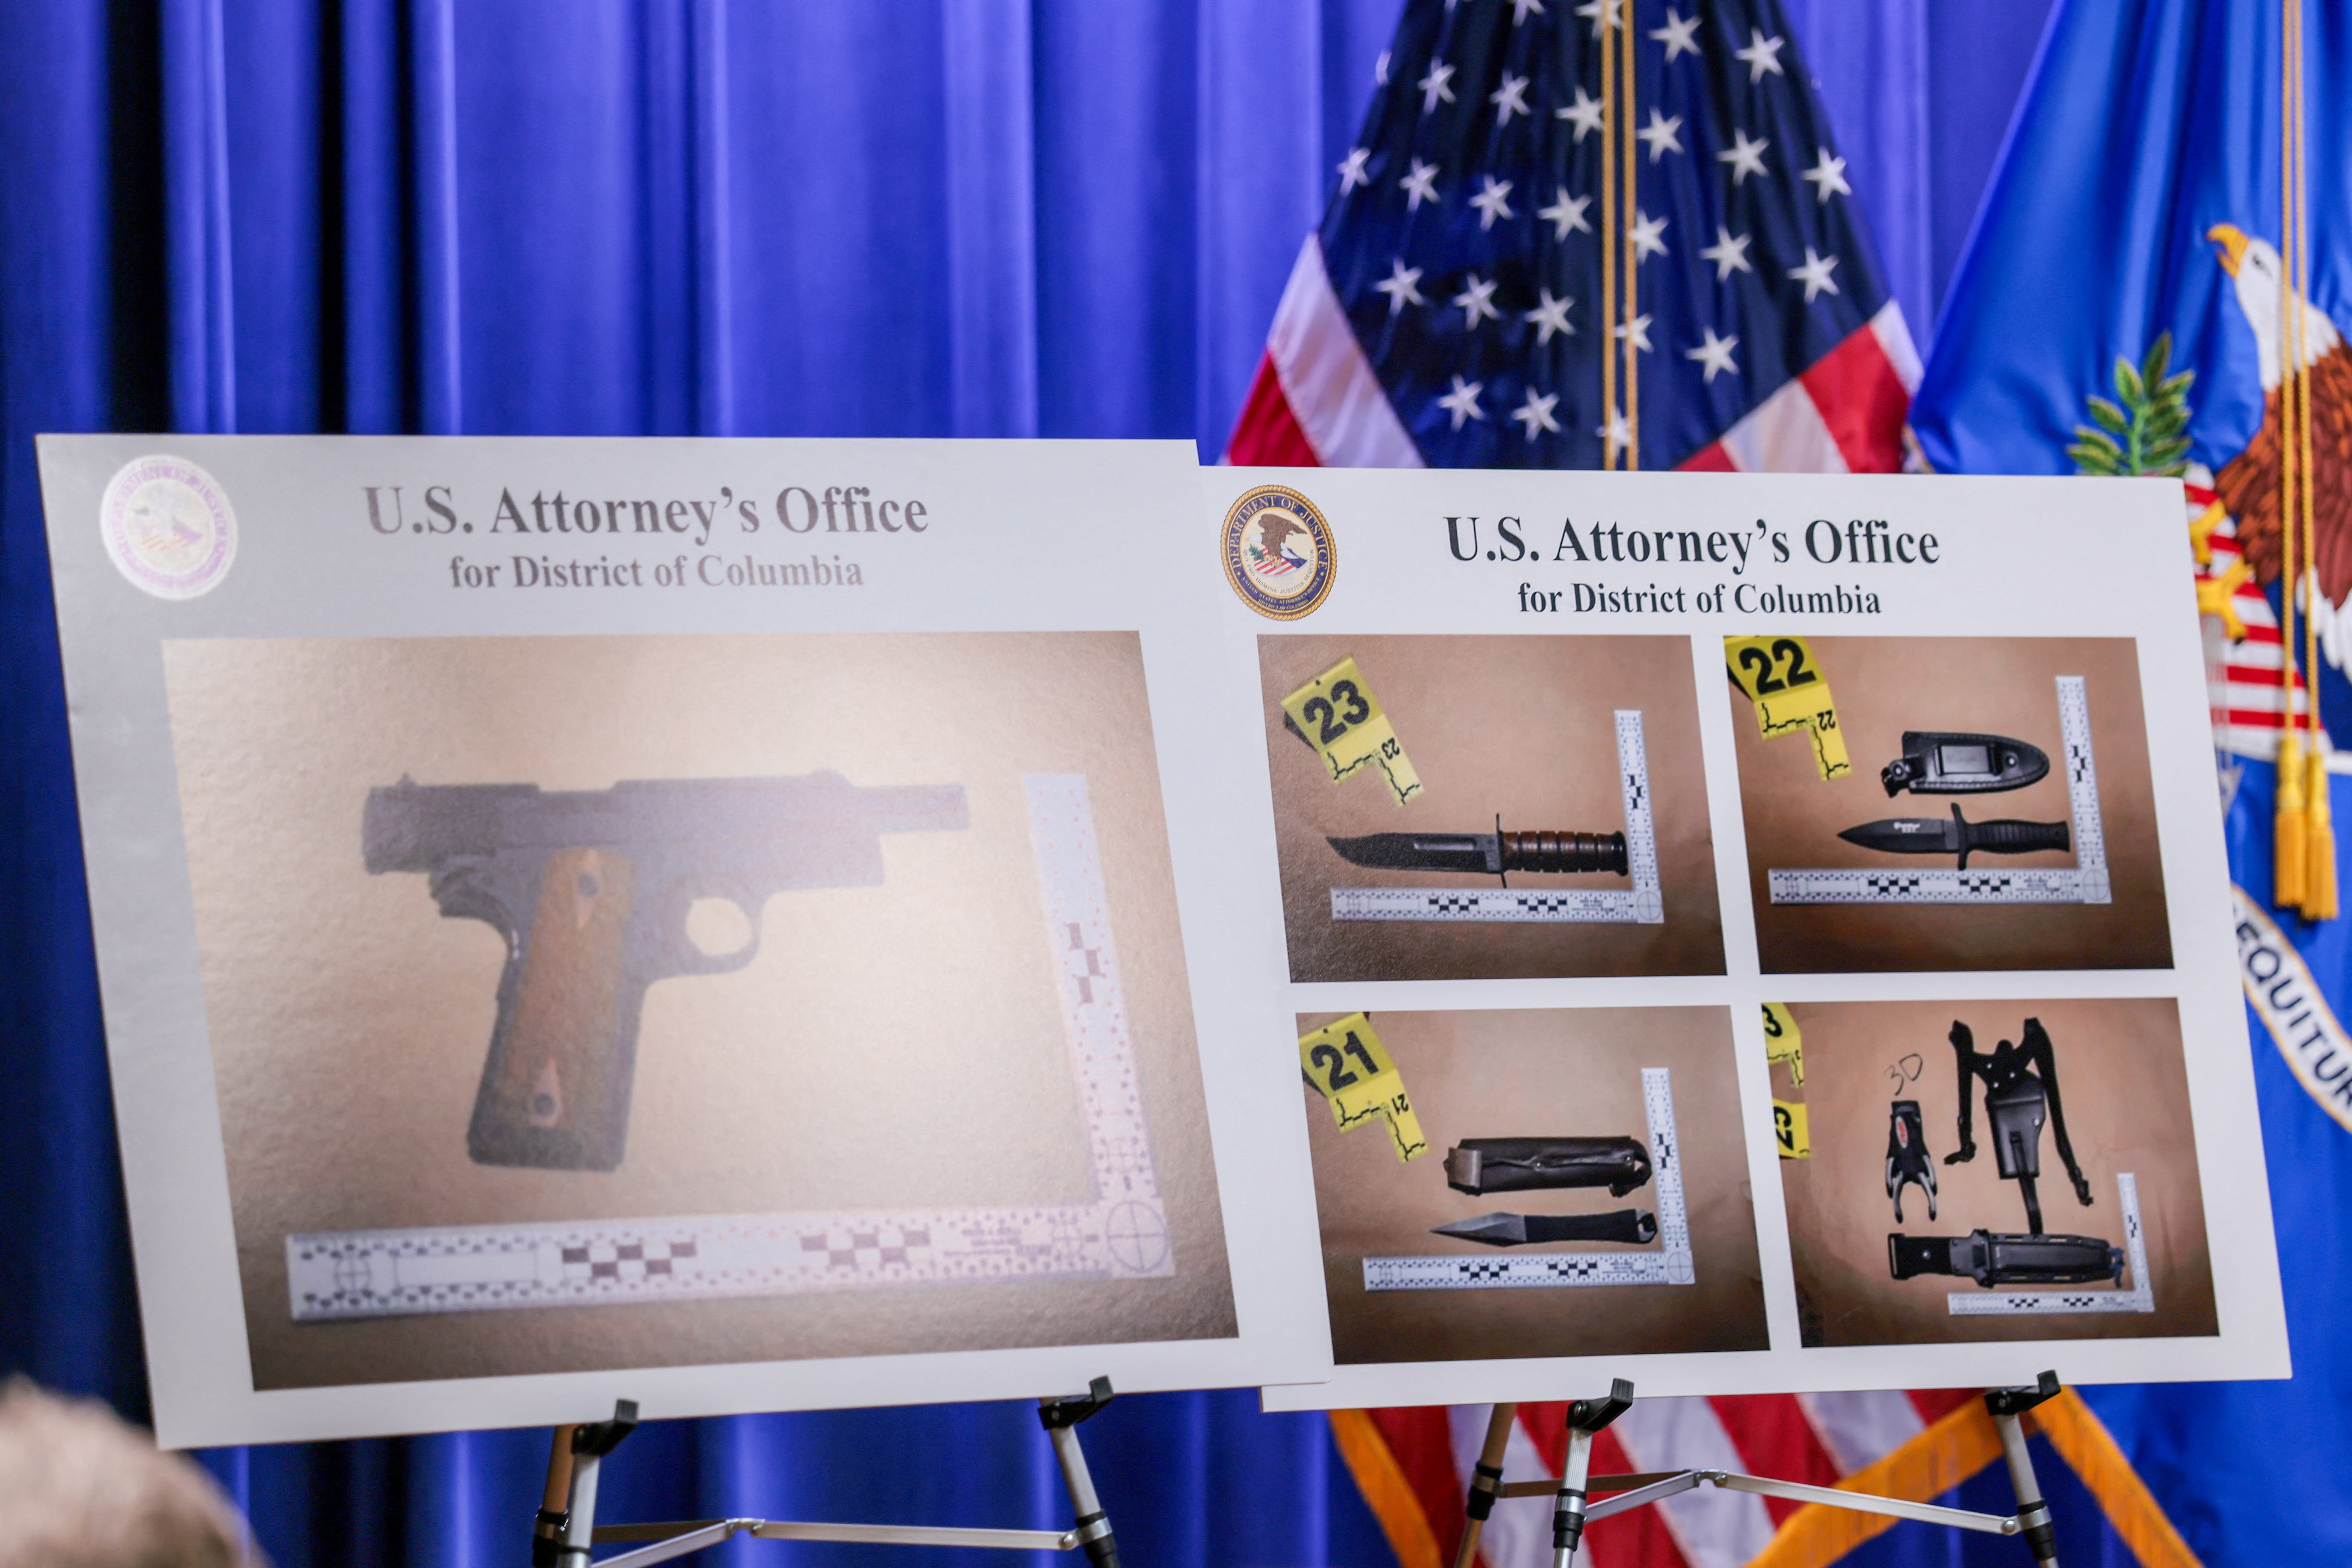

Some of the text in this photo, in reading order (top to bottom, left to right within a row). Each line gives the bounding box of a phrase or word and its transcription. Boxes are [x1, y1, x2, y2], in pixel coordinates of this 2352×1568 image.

[363, 486, 929, 546] U.S. Attorney’s Office
[1230, 495, 1328, 569] DEPARTMENT OF JUSTICE
[1443, 516, 1940, 574] U.S. Attorney’s Office
[450, 554, 865, 589] for District of Columbia
[1518, 582, 1882, 614] for District of Columbia
[1739, 638, 1817, 696] 22
[1303, 679, 1370, 745] 23
[1817, 709, 1836, 731] 22
[1381, 737, 1400, 760] 23
[2234, 903, 2352, 1106] EQUITUR
[1310, 1030, 1379, 1091] 21
[1391, 1093, 1409, 1115] 21
